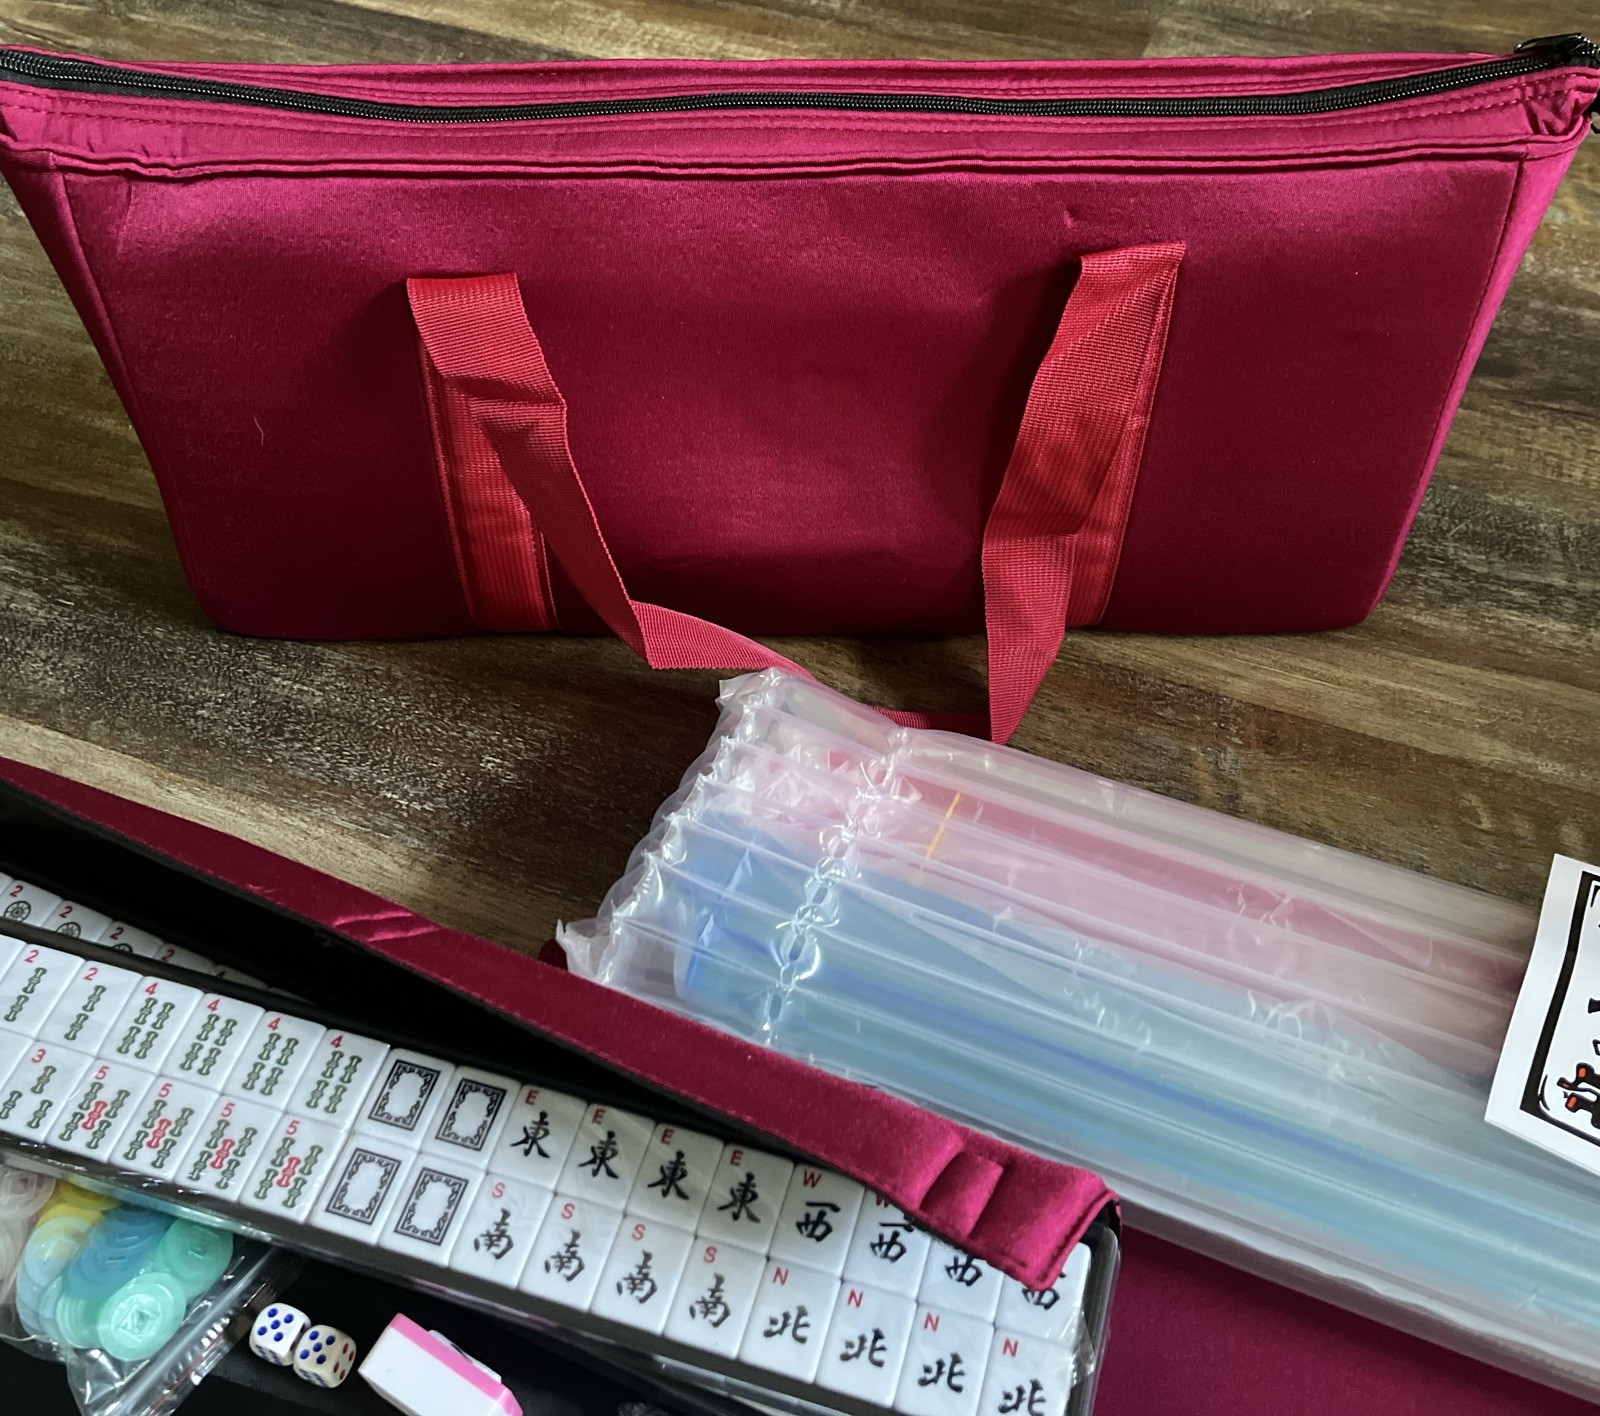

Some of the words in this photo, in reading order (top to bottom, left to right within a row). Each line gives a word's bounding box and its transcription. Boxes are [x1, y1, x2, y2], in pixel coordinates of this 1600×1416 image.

[9, 882, 24, 897] 2
[59, 904, 73, 919] 2
[109, 923, 125, 941] 2
[24, 948, 40, 964] 2
[161, 948, 175, 963] 2
[83, 966, 98, 982] 2
[145, 982, 157, 996] 4
[207, 998, 221, 1012] 4
[267, 1017, 281, 1030] 4
[330, 1035, 344, 1049] 4
[31, 1047, 47, 1064] 3
[95, 1064, 109, 1081] 5
[158, 1082, 172, 1098] 5
[525, 1087, 537, 1105] E
[219, 1101, 235, 1119] 5
[591, 1106, 608, 1123] E
[286, 1119, 299, 1136] 5
[510, 1111, 551, 1159] 東
[660, 1125, 674, 1144] E
[578, 1130, 620, 1180] 東
[729, 1147, 743, 1165] E
[647, 1150, 690, 1201] 東
[802, 1170, 821, 1187] W
[491, 1181, 505, 1199] S
[717, 1172, 761, 1223] 東
[560, 1202, 575, 1220] S
[795, 1200, 842, 1243] 西
[473, 1208, 514, 1260] 南
[631, 1222, 646, 1240] S
[870, 1222, 914, 1263] 西
[544, 1229, 585, 1282] 南
[703, 1245, 718, 1263] S
[616, 1250, 658, 1305] 南
[772, 1267, 788, 1285] N
[689, 1273, 731, 1329] 南
[847, 1289, 864, 1308] N
[763, 1305, 811, 1345] 北
[922, 1312, 939, 1332] N
[839, 1328, 887, 1368] 北
[1002, 1338, 1019, 1357] N
[917, 1352, 965, 1394] 北
[997, 1379, 1046, 1416] 北
